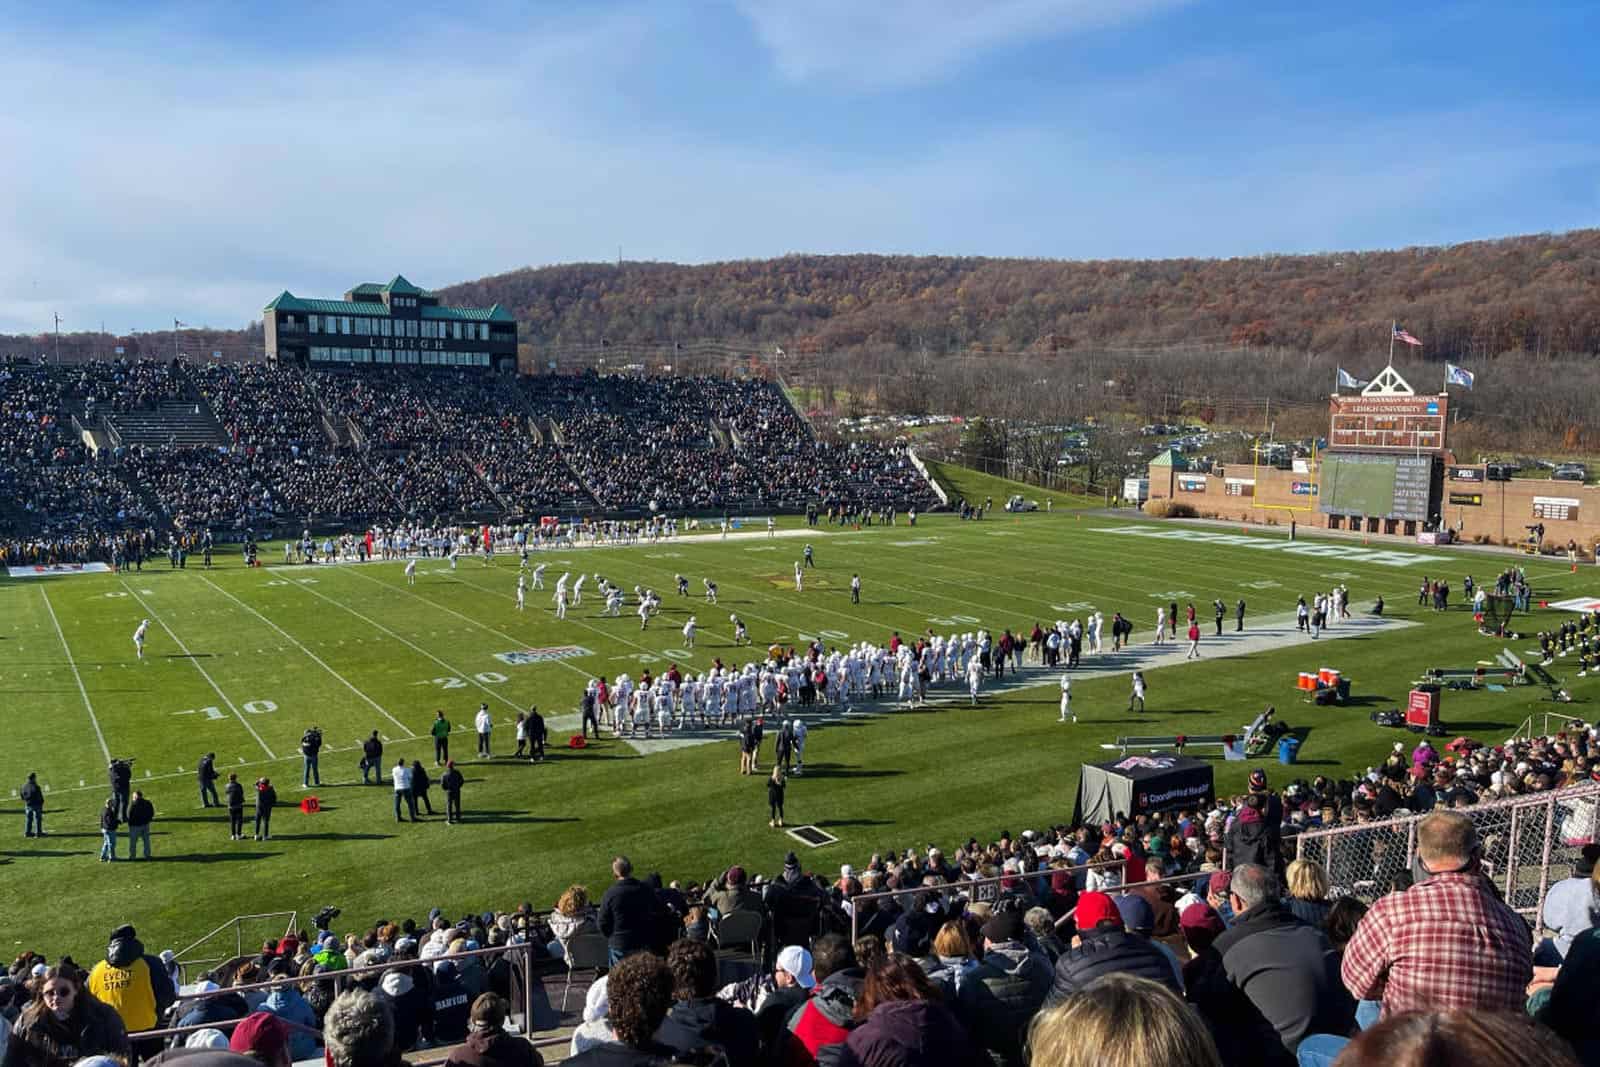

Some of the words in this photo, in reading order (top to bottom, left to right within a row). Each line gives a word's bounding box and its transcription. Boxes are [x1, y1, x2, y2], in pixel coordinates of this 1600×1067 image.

[369, 337, 444, 350] LEHIGH
[432, 672, 508, 689] 20
[205, 700, 278, 720] 10
[103, 969, 132, 981] EVENT
[103, 980, 130, 991] STAFF
